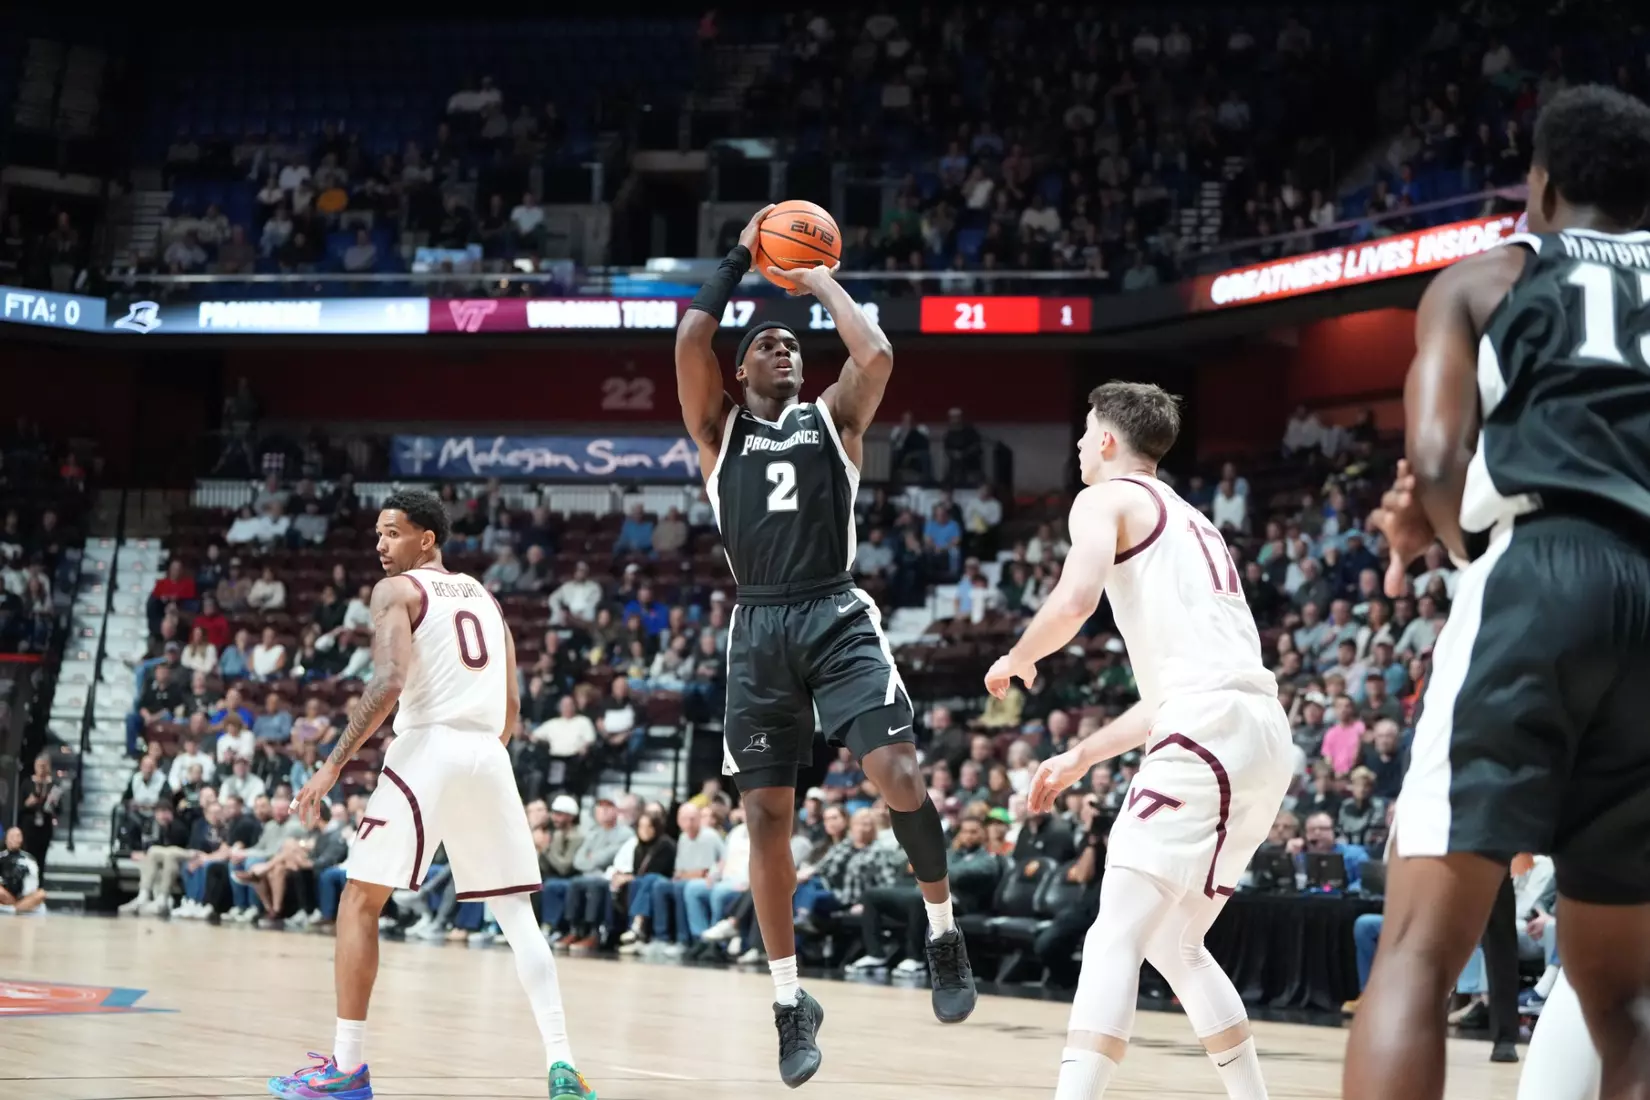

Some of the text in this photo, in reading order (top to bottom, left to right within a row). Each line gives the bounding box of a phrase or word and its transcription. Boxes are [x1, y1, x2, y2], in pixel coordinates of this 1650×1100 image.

[1344, 239, 1413, 279] LIVES
[5, 293, 80, 326] FTA: 0
[954, 302, 986, 330] 21
[1060, 305, 1074, 327] 1
[601, 376, 655, 411] 22
[584, 438, 653, 476] Sun
[740, 430, 820, 456] PROVIDENCE
[765, 460, 799, 512] 2
[1187, 517, 1240, 597] 17
[453, 609, 490, 672] 0
